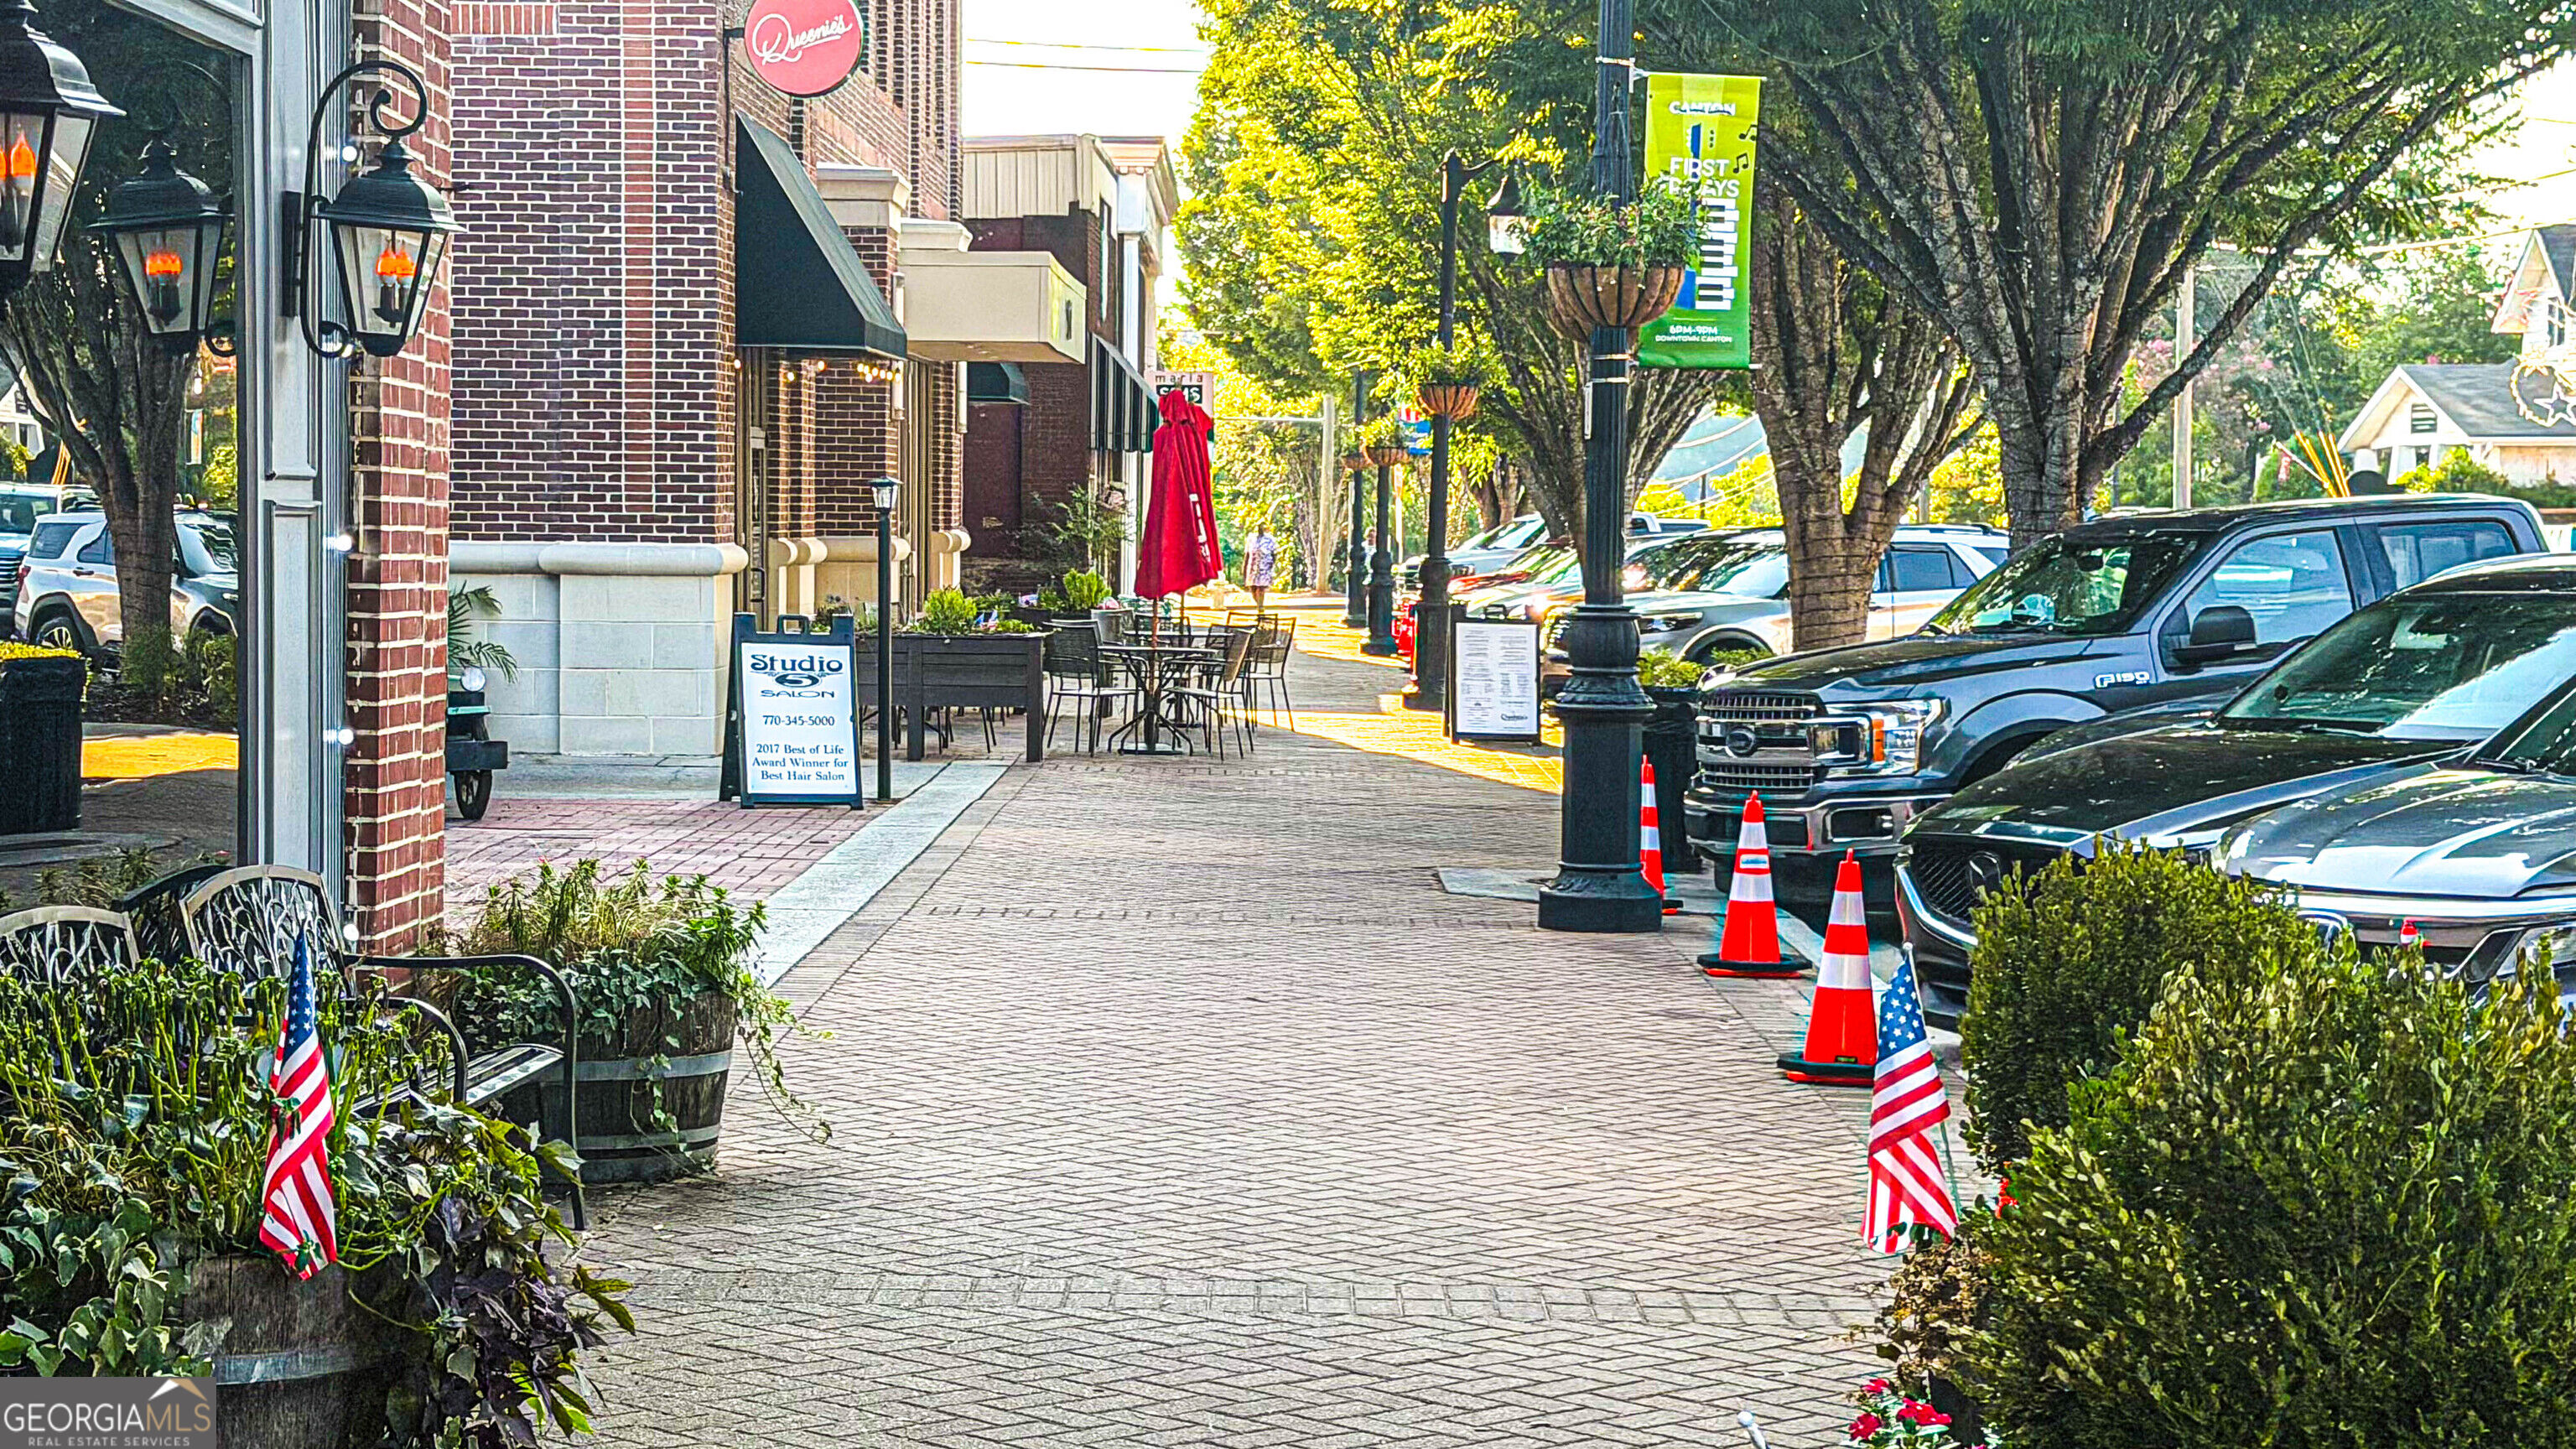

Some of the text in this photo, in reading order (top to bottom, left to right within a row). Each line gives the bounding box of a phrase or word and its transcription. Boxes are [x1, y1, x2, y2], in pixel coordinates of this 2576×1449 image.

[752, 13, 853, 66] Queenie's
[1669, 101, 1736, 116] CANTON
[1670, 157, 1730, 182] FIRST
[1670, 325, 1717, 335] 6PM-9PM
[750, 654, 843, 672] Studio
[761, 689, 834, 698] SALON
[762, 714, 835, 726] 770-345-5000
[756, 743, 844, 754] 2017 Best of Life
[752, 757, 849, 767] Award Winner for
[761, 770, 844, 781] Best Hair Salon
